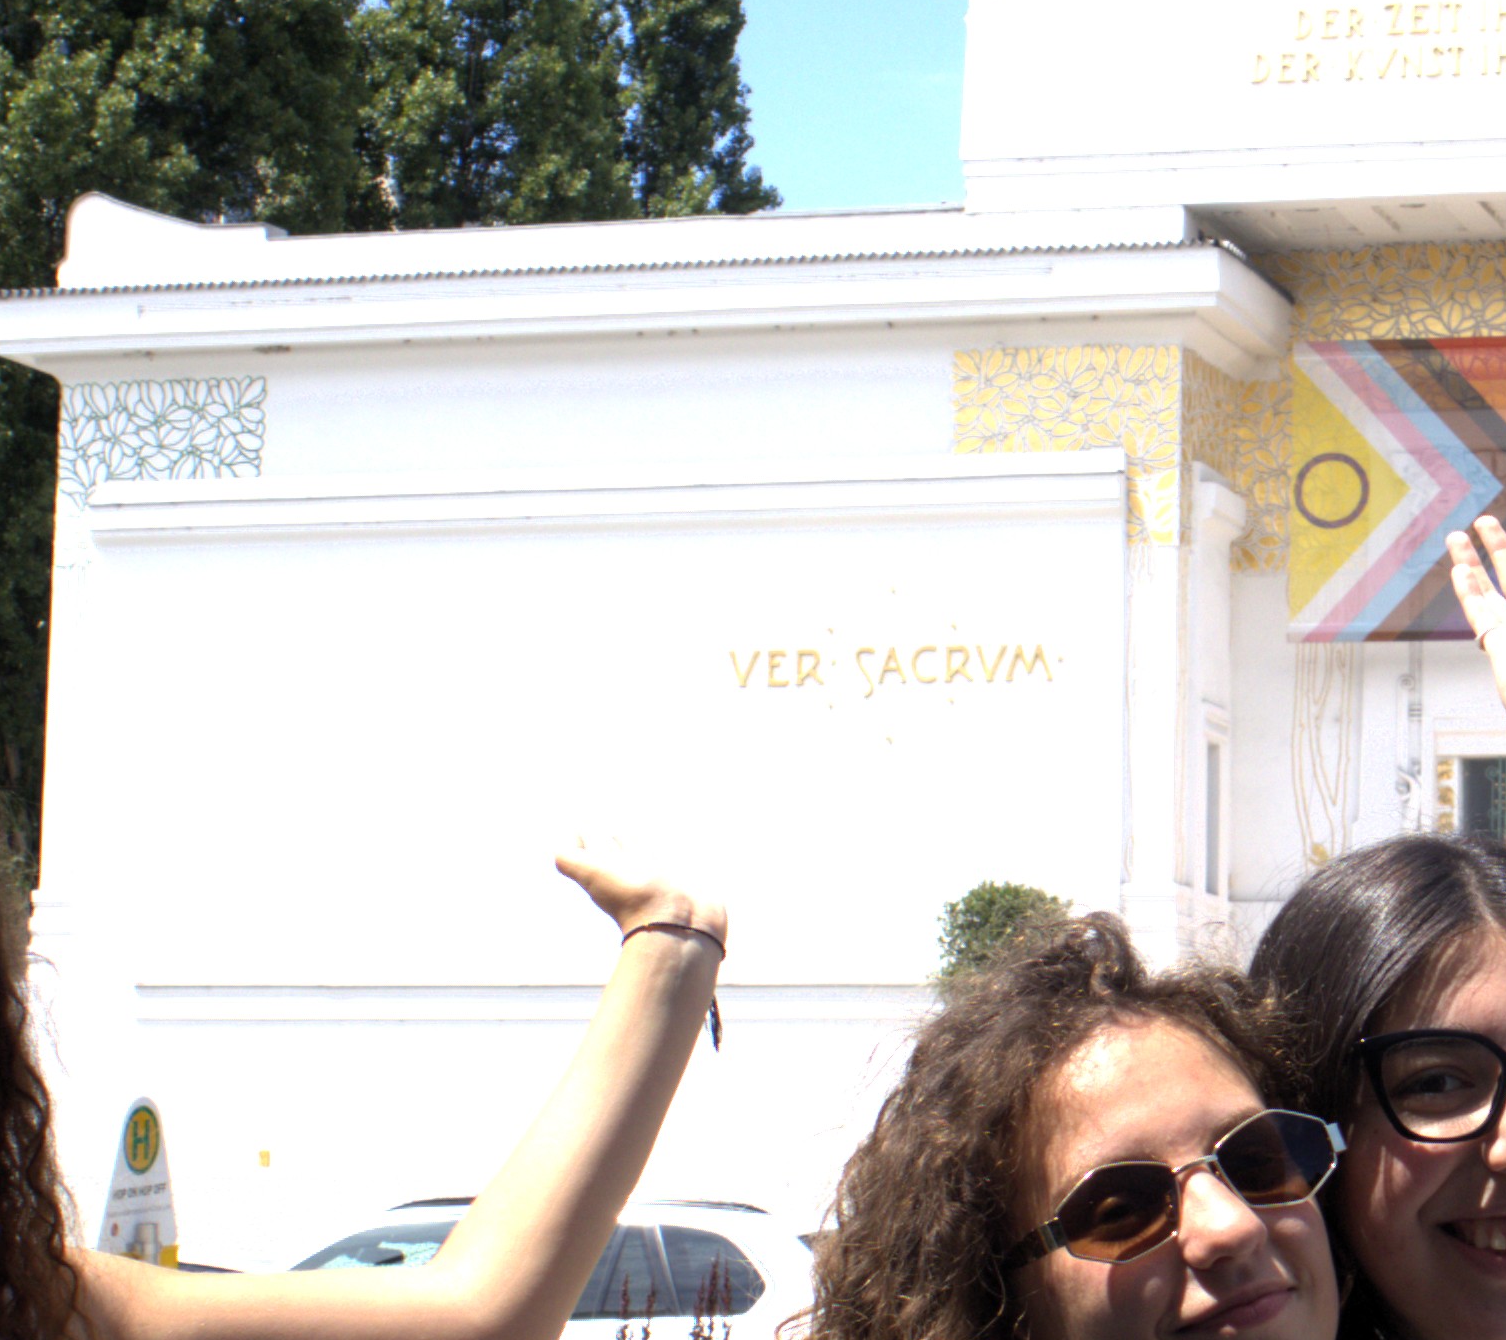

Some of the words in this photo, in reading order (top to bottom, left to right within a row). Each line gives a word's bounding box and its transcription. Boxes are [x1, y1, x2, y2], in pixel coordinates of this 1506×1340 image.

[1294, 8, 1364, 40] DER
[1384, 2, 1462, 36] ZEIT
[1251, 52, 1320, 84] DER
[729, 648, 825, 687] VER
[855, 644, 1053, 700] SACRVM
[132, 1119, 150, 1162] H
